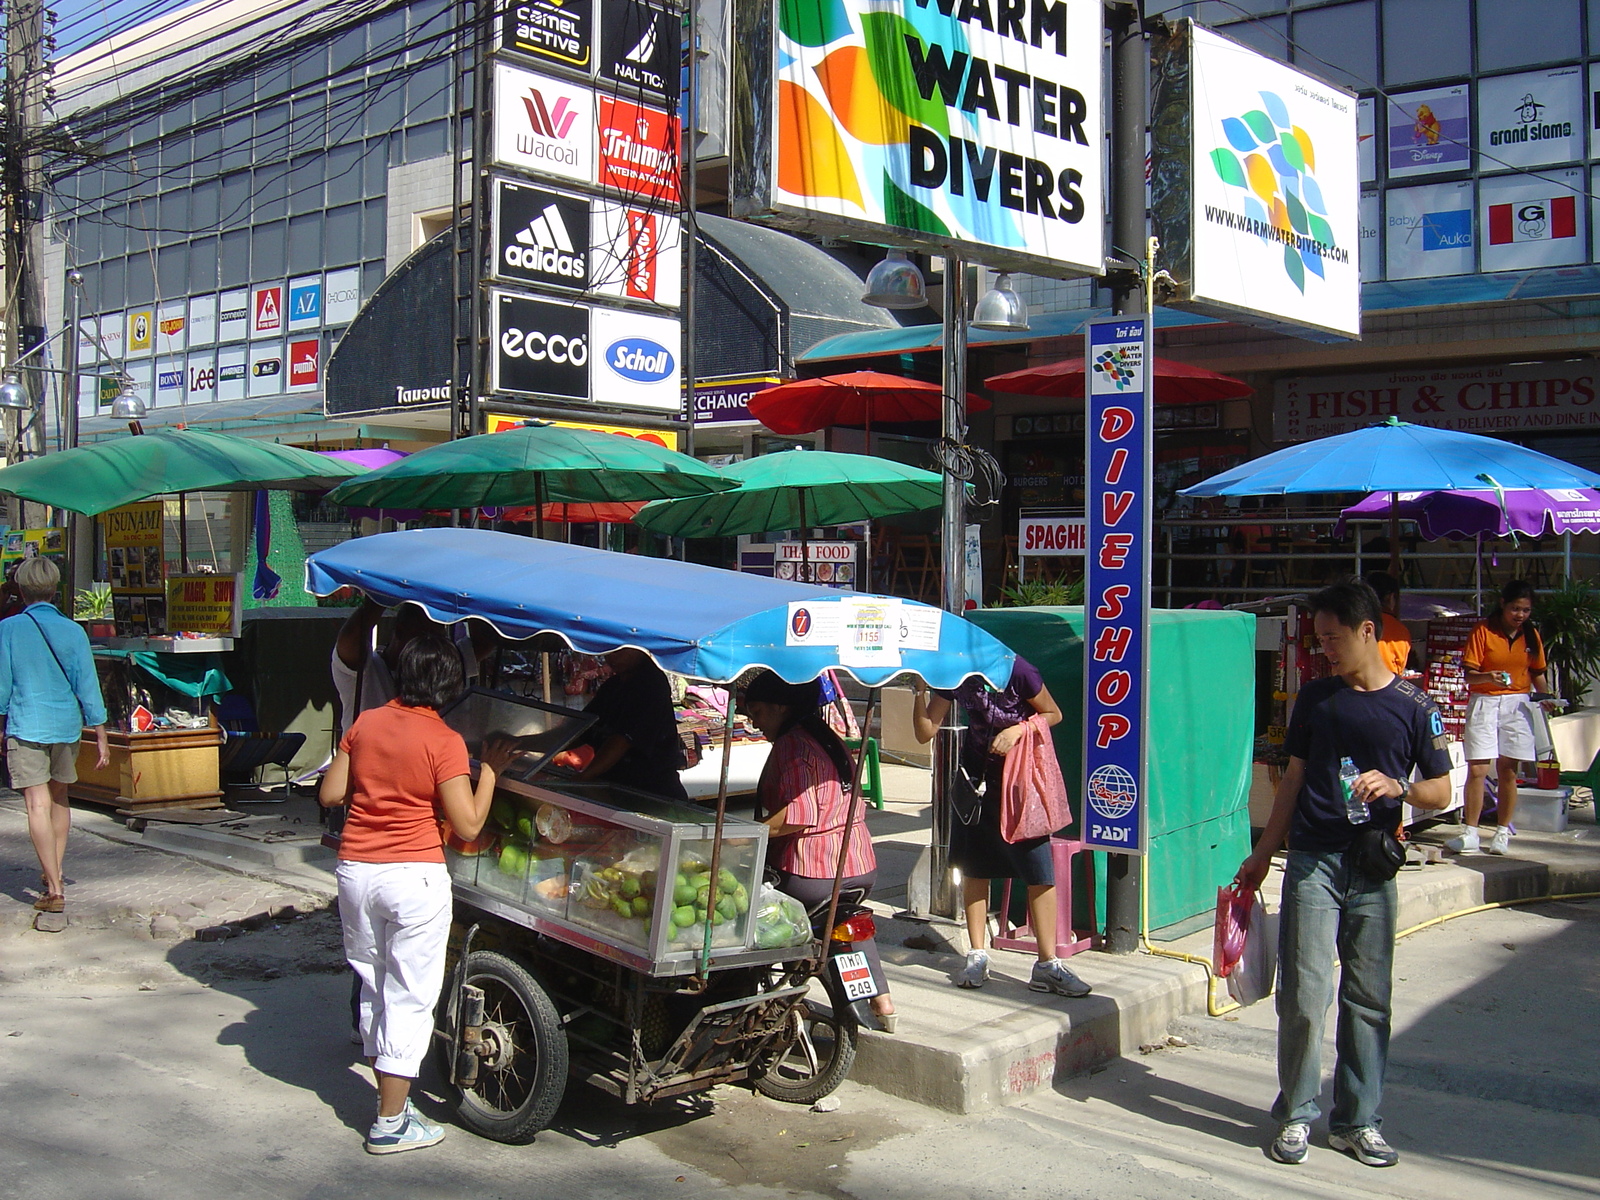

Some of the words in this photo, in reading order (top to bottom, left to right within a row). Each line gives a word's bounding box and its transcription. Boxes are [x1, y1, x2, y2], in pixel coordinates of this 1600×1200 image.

[904, 34, 1089, 147] WATER
[516, 133, 578, 167] Wacoal
[601, 128, 679, 175] Triumph
[909, 124, 1085, 225] DIVERS
[1389, 215, 1416, 227] Baby
[1204, 204, 1349, 264] WWW.WARMWATERDIVERS.COM
[505, 244, 585, 279] adidas
[295, 292, 316, 315] AZ
[328, 289, 358, 304] HOM
[501, 327, 587, 366] ecco
[1120, 352, 1142, 360] WATER
[614, 345, 669, 374] Scholl
[190, 367, 215, 392] Lee
[1307, 388, 1402, 419] FISH
[1412, 385, 1446, 414] &
[1457, 376, 1595, 411] CHIPS
[1458, 416, 1520, 430] DELIVERY
[1523, 414, 1553, 427] AND
[1556, 412, 1586, 425] DINE
[1013, 477, 1048, 487] BURGERS
[1063, 476, 1079, 485] HOT
[108, 510, 161, 538] TSUNAMI
[1025, 524, 1086, 550] SPAGHE
[816, 546, 851, 559] FOOD
[184, 581, 206, 602] MAGIC
[859, 631, 879, 642] 1155
[1092, 824, 1129, 842] PADI
[849, 981, 872, 997] 249
